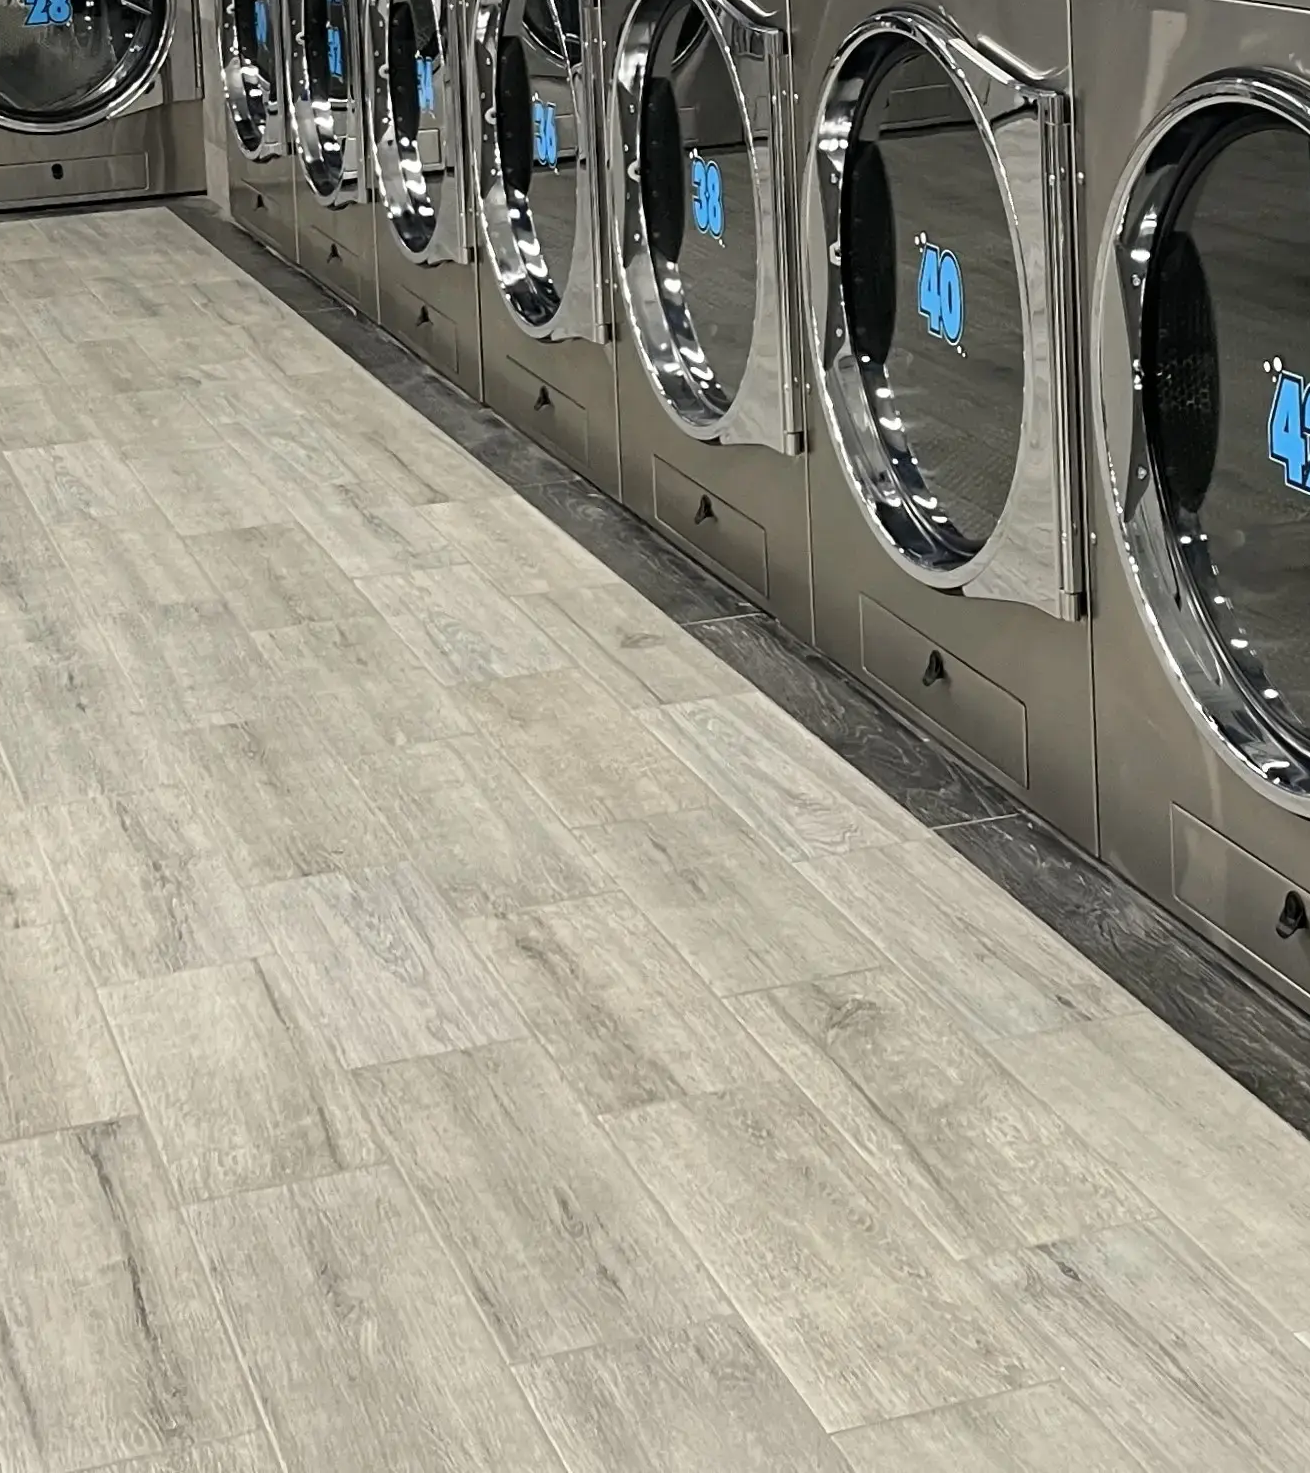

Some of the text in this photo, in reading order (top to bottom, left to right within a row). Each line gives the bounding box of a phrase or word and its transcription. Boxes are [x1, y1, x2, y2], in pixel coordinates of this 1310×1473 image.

[532, 106, 557, 164] 36
[691, 161, 724, 234] 38
[918, 249, 963, 341] 40
